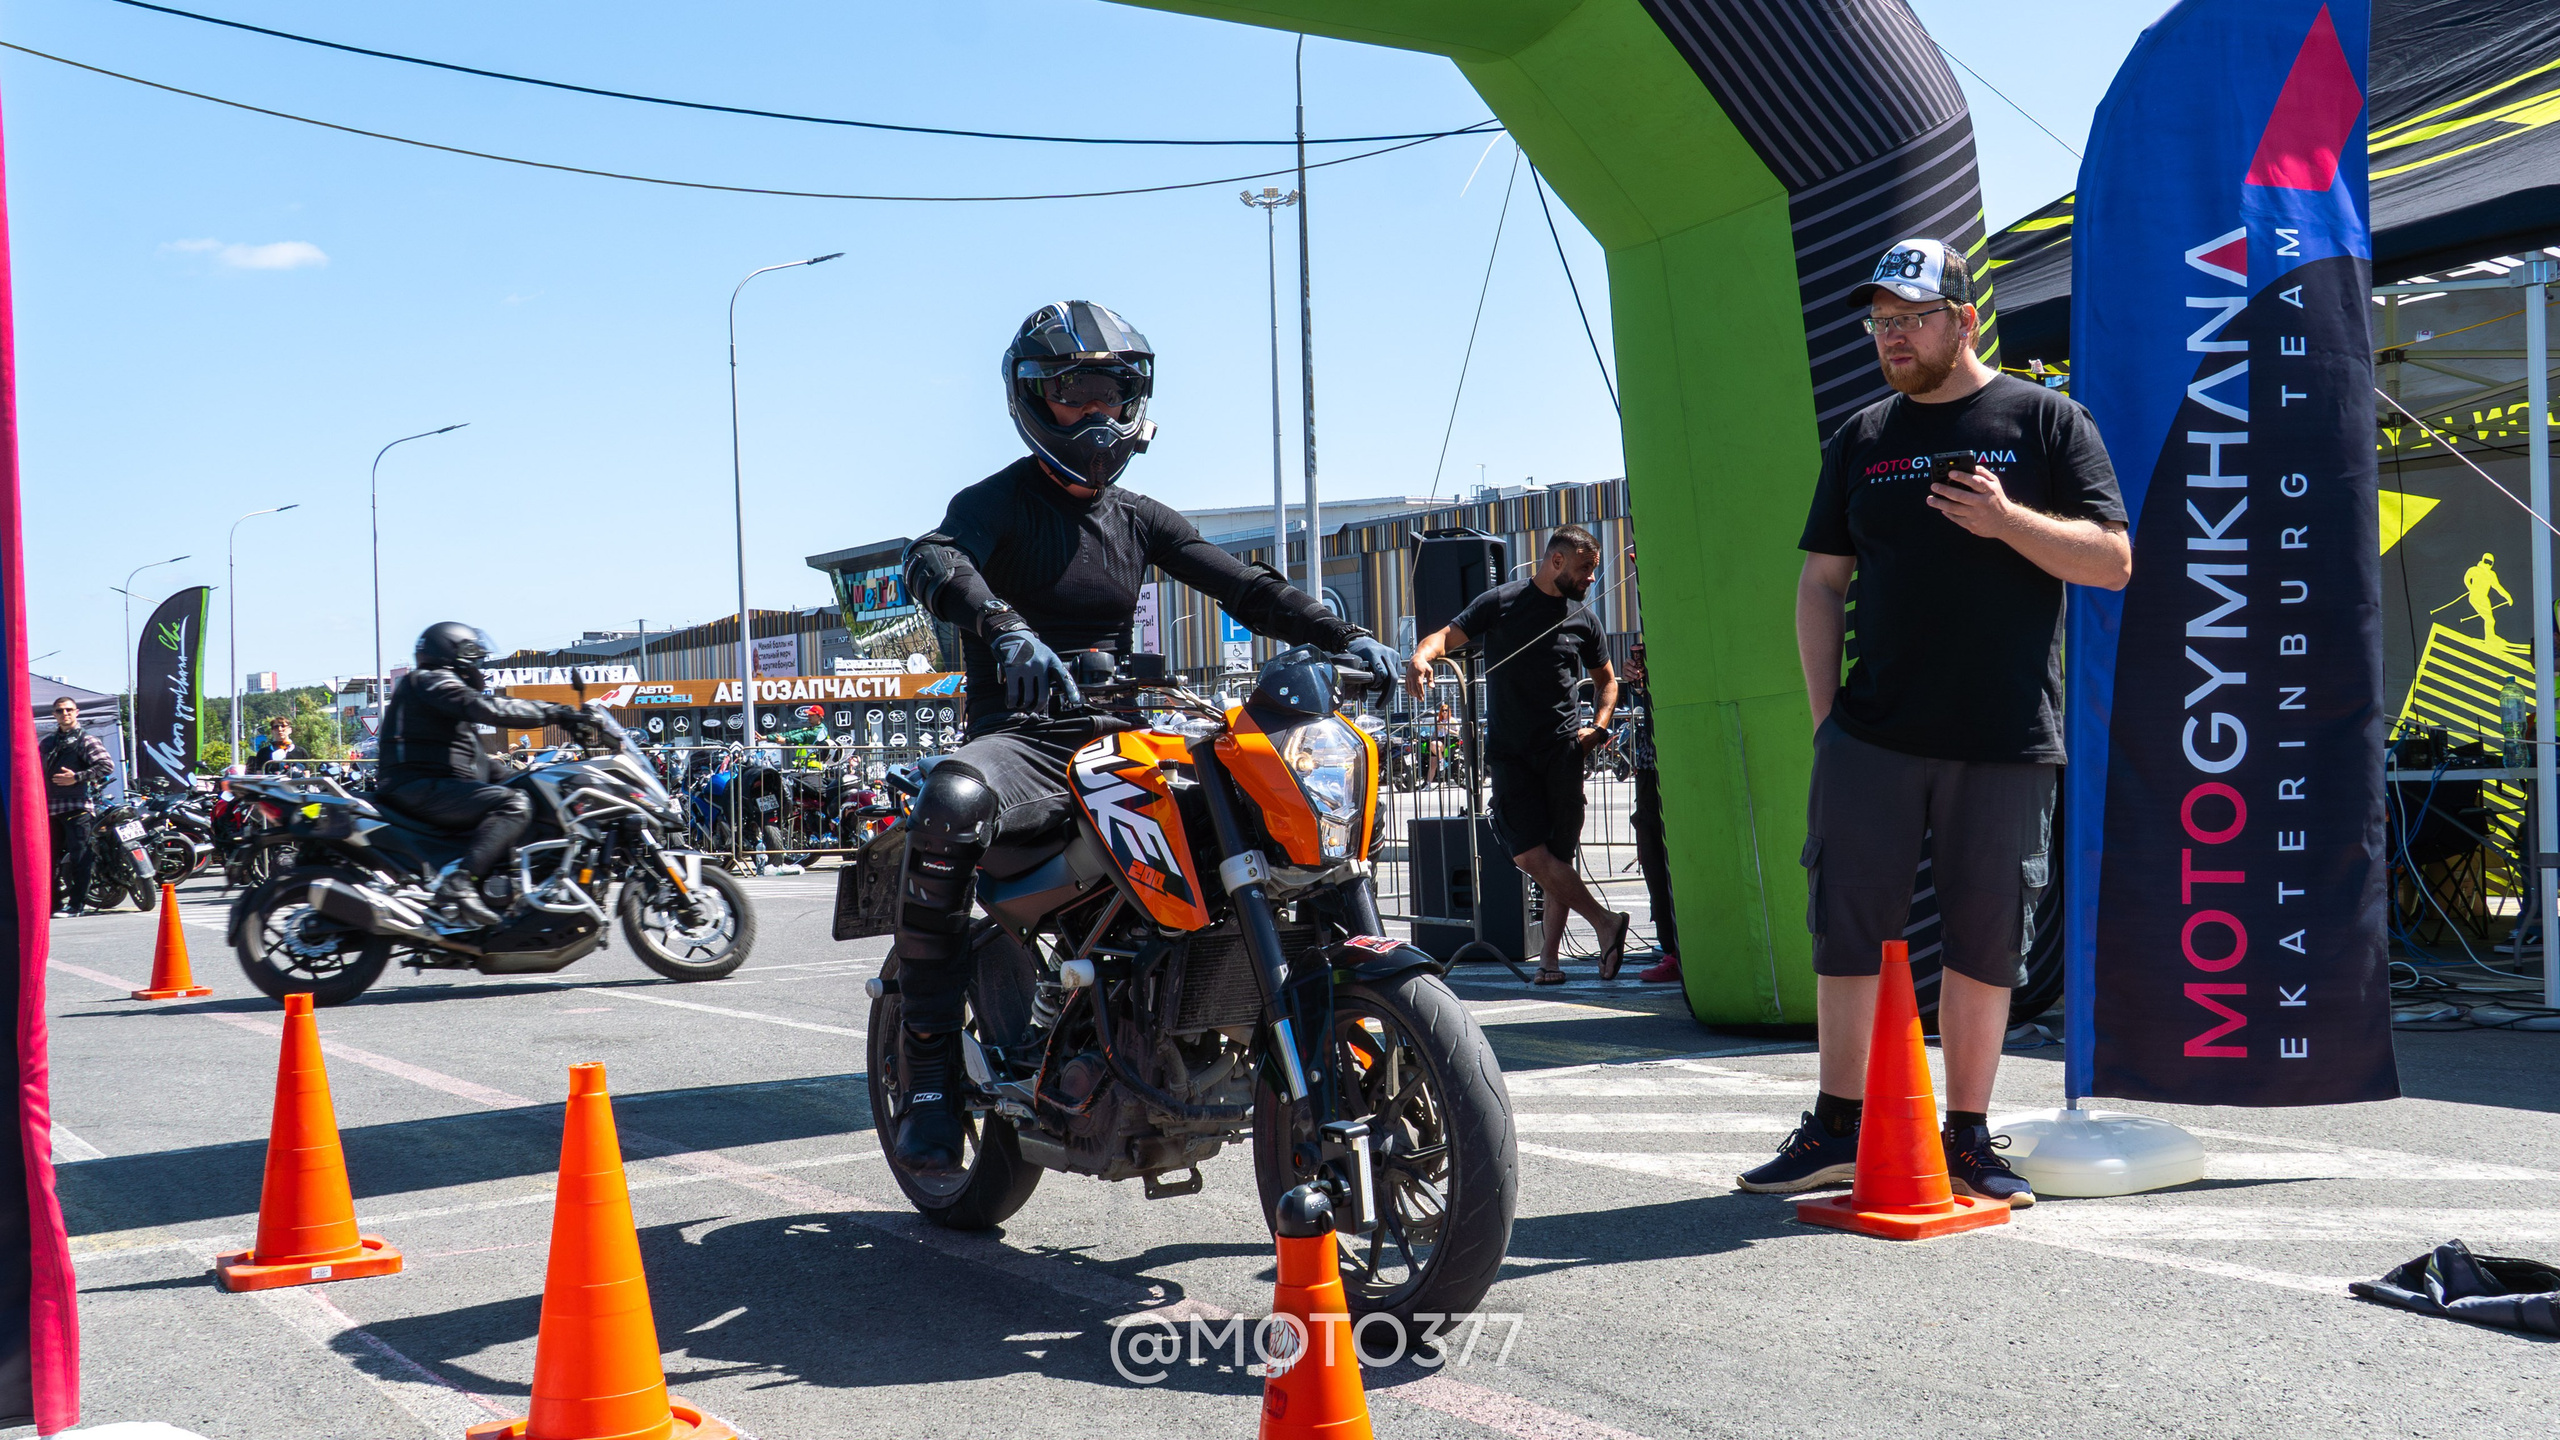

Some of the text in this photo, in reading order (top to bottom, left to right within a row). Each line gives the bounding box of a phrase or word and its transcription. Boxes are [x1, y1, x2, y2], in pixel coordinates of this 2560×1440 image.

[1865, 450, 2017, 475] MOTOGYANA
[2180, 226, 2249, 1058] MOTOGYMKHANA
[2275, 228, 2309, 1059] EKATERINBURG TEAM
[634, 694, 693, 704] ЯПОНЕЦ
[636, 685, 674, 694] АВТО
[714, 677, 900, 703] АВТОЗАПЧАСТИ
[1074, 733, 1183, 878] DUKE
[1127, 859, 1167, 893] 200
